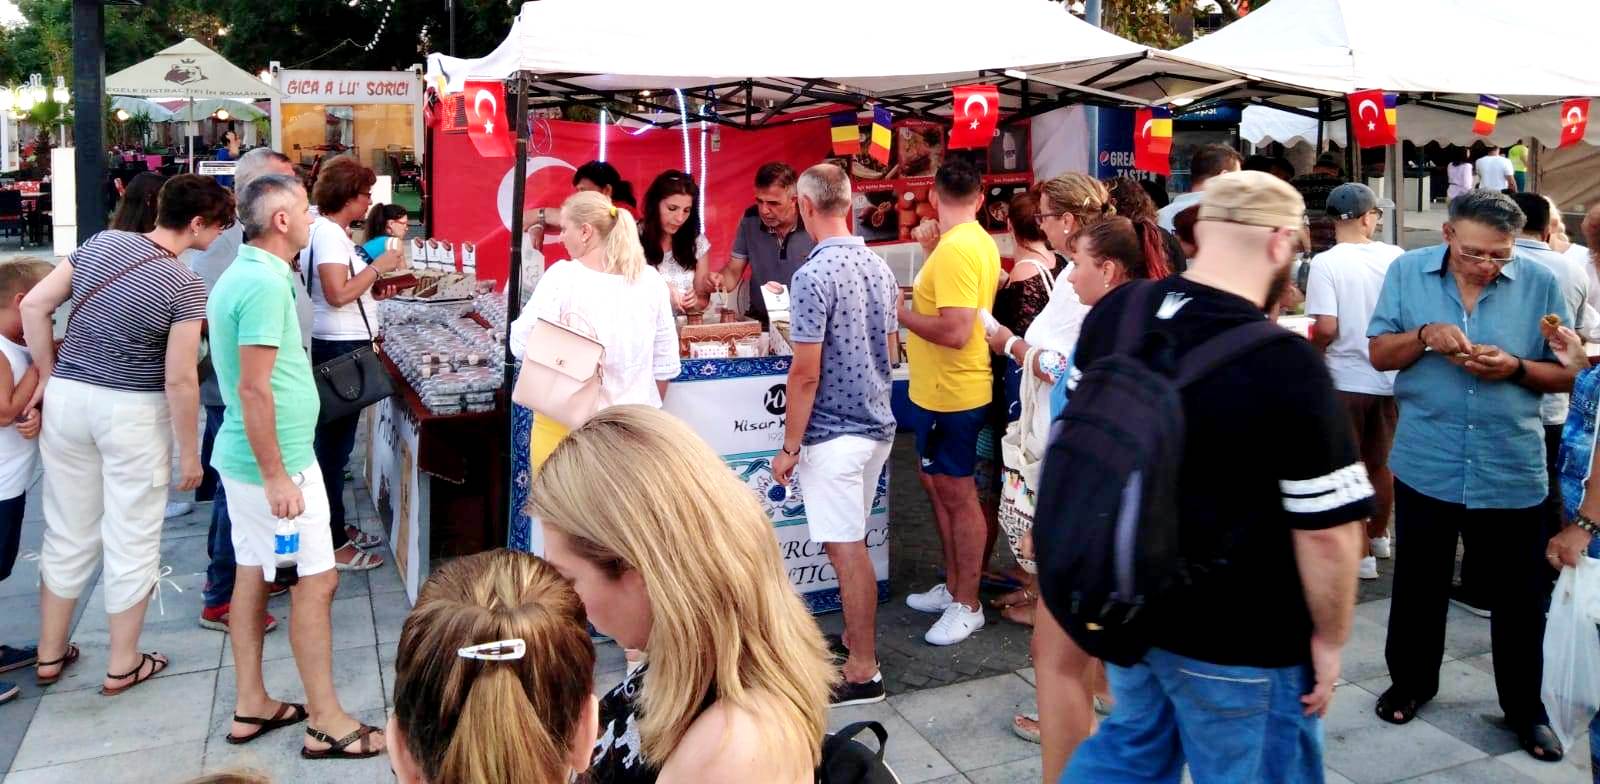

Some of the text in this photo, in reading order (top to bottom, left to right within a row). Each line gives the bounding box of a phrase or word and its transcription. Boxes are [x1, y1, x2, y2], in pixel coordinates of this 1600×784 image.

[287, 79, 319, 95] GICA
[324, 80, 334, 95] A
[1110, 151, 1136, 167] GREA
[768, 432, 784, 441] 192
